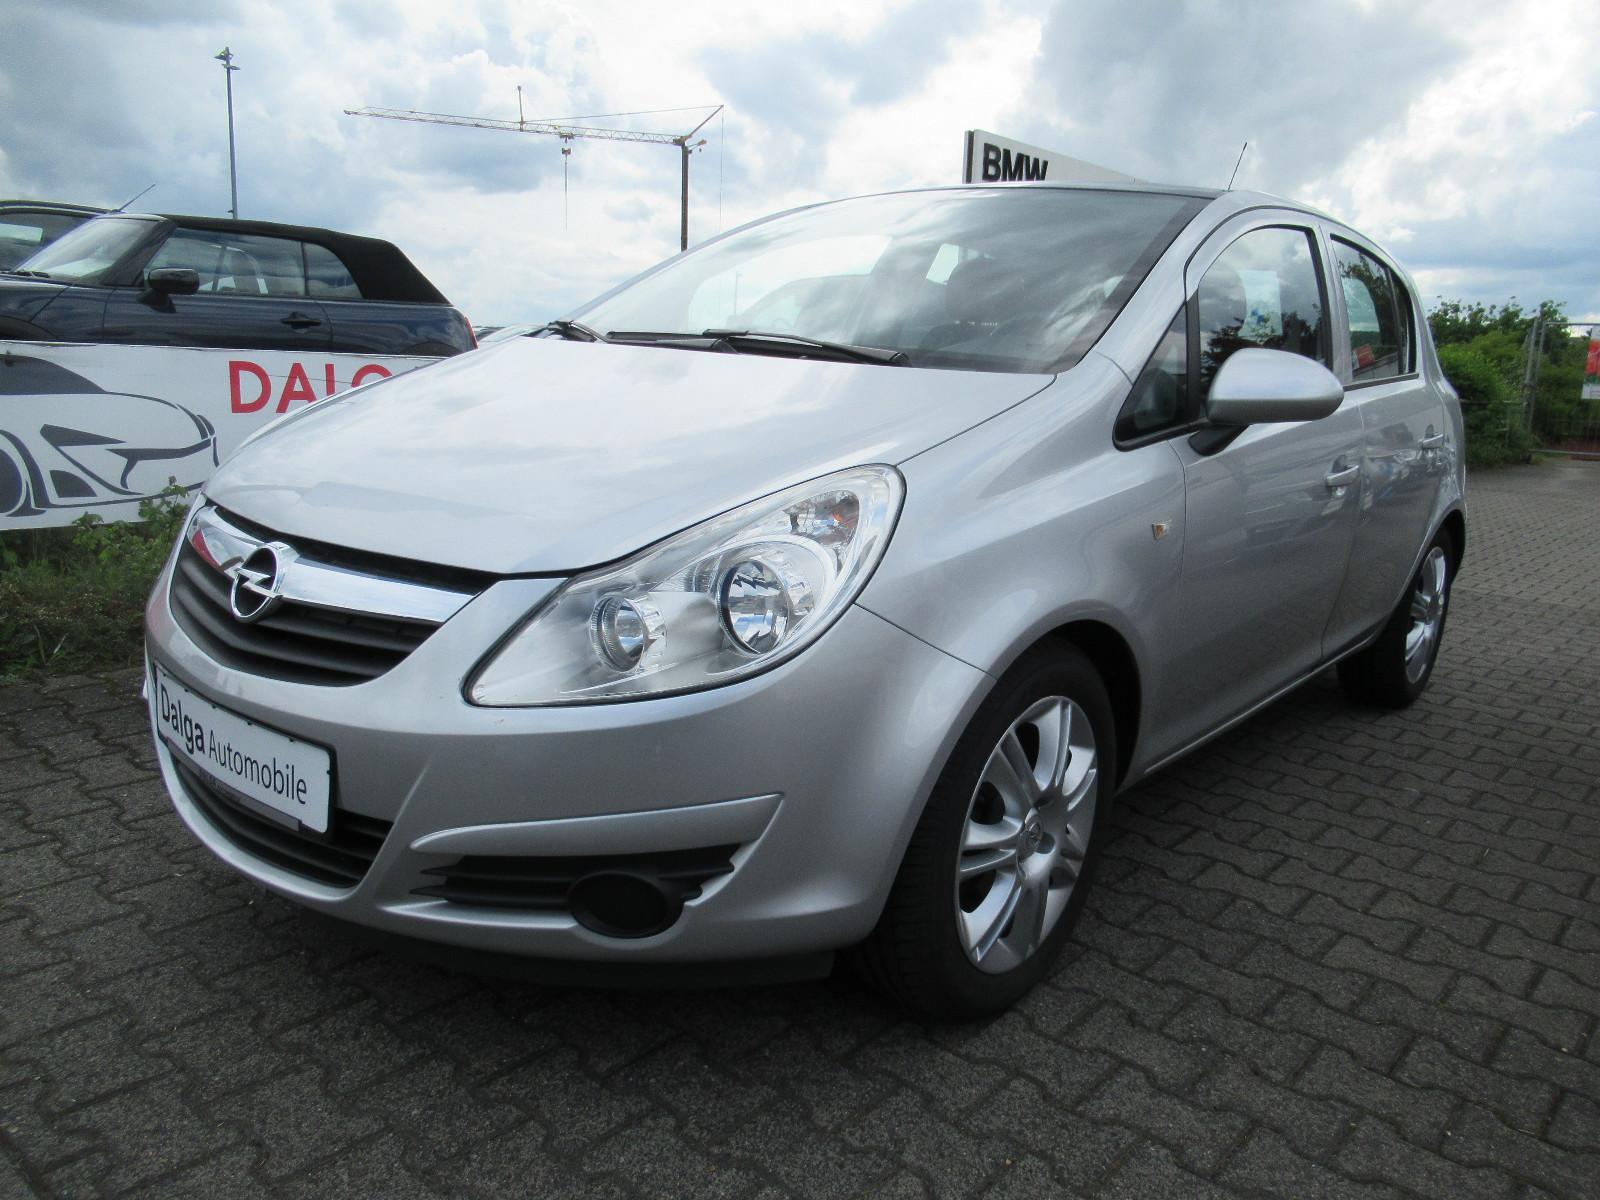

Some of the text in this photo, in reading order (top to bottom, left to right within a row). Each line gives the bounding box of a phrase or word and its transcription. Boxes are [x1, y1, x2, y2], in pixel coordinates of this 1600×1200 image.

[982, 142, 1048, 183] BMW
[161, 682, 307, 805] Dalga Automobile
